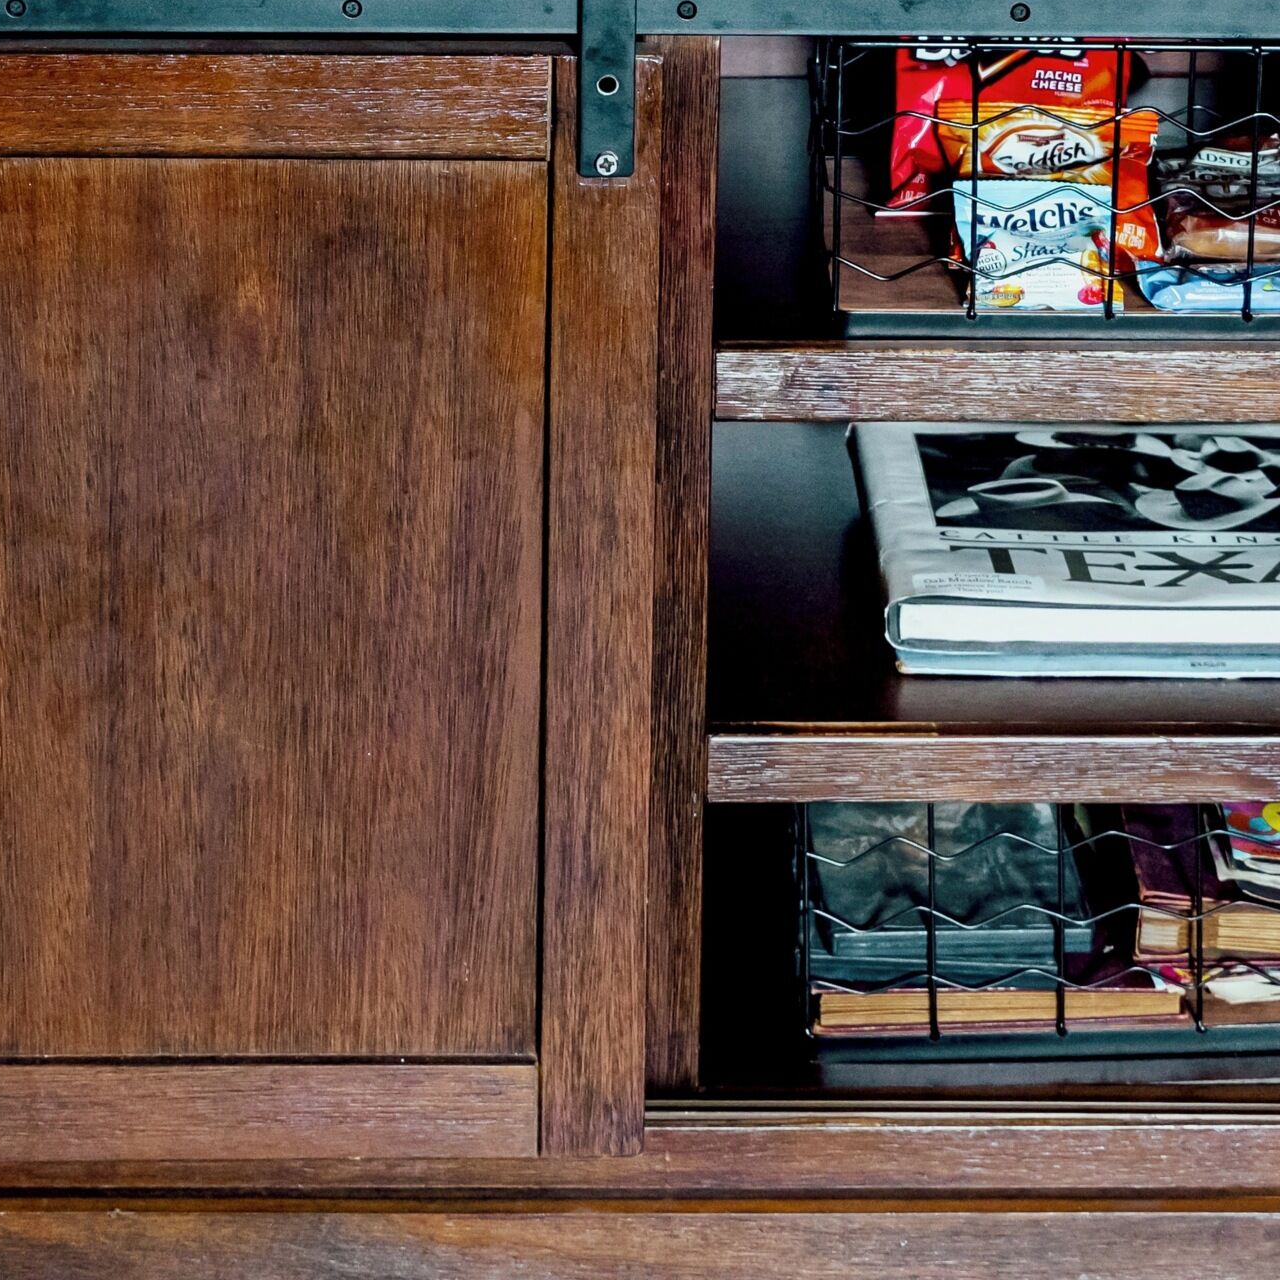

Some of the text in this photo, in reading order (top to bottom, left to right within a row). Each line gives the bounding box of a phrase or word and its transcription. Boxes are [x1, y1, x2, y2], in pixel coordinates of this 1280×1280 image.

[1035, 69, 1082, 83] NACHO
[1031, 79, 1082, 93] CHEESE
[998, 142, 1088, 169] Goldfish
[939, 530, 1133, 543] CATTLE
